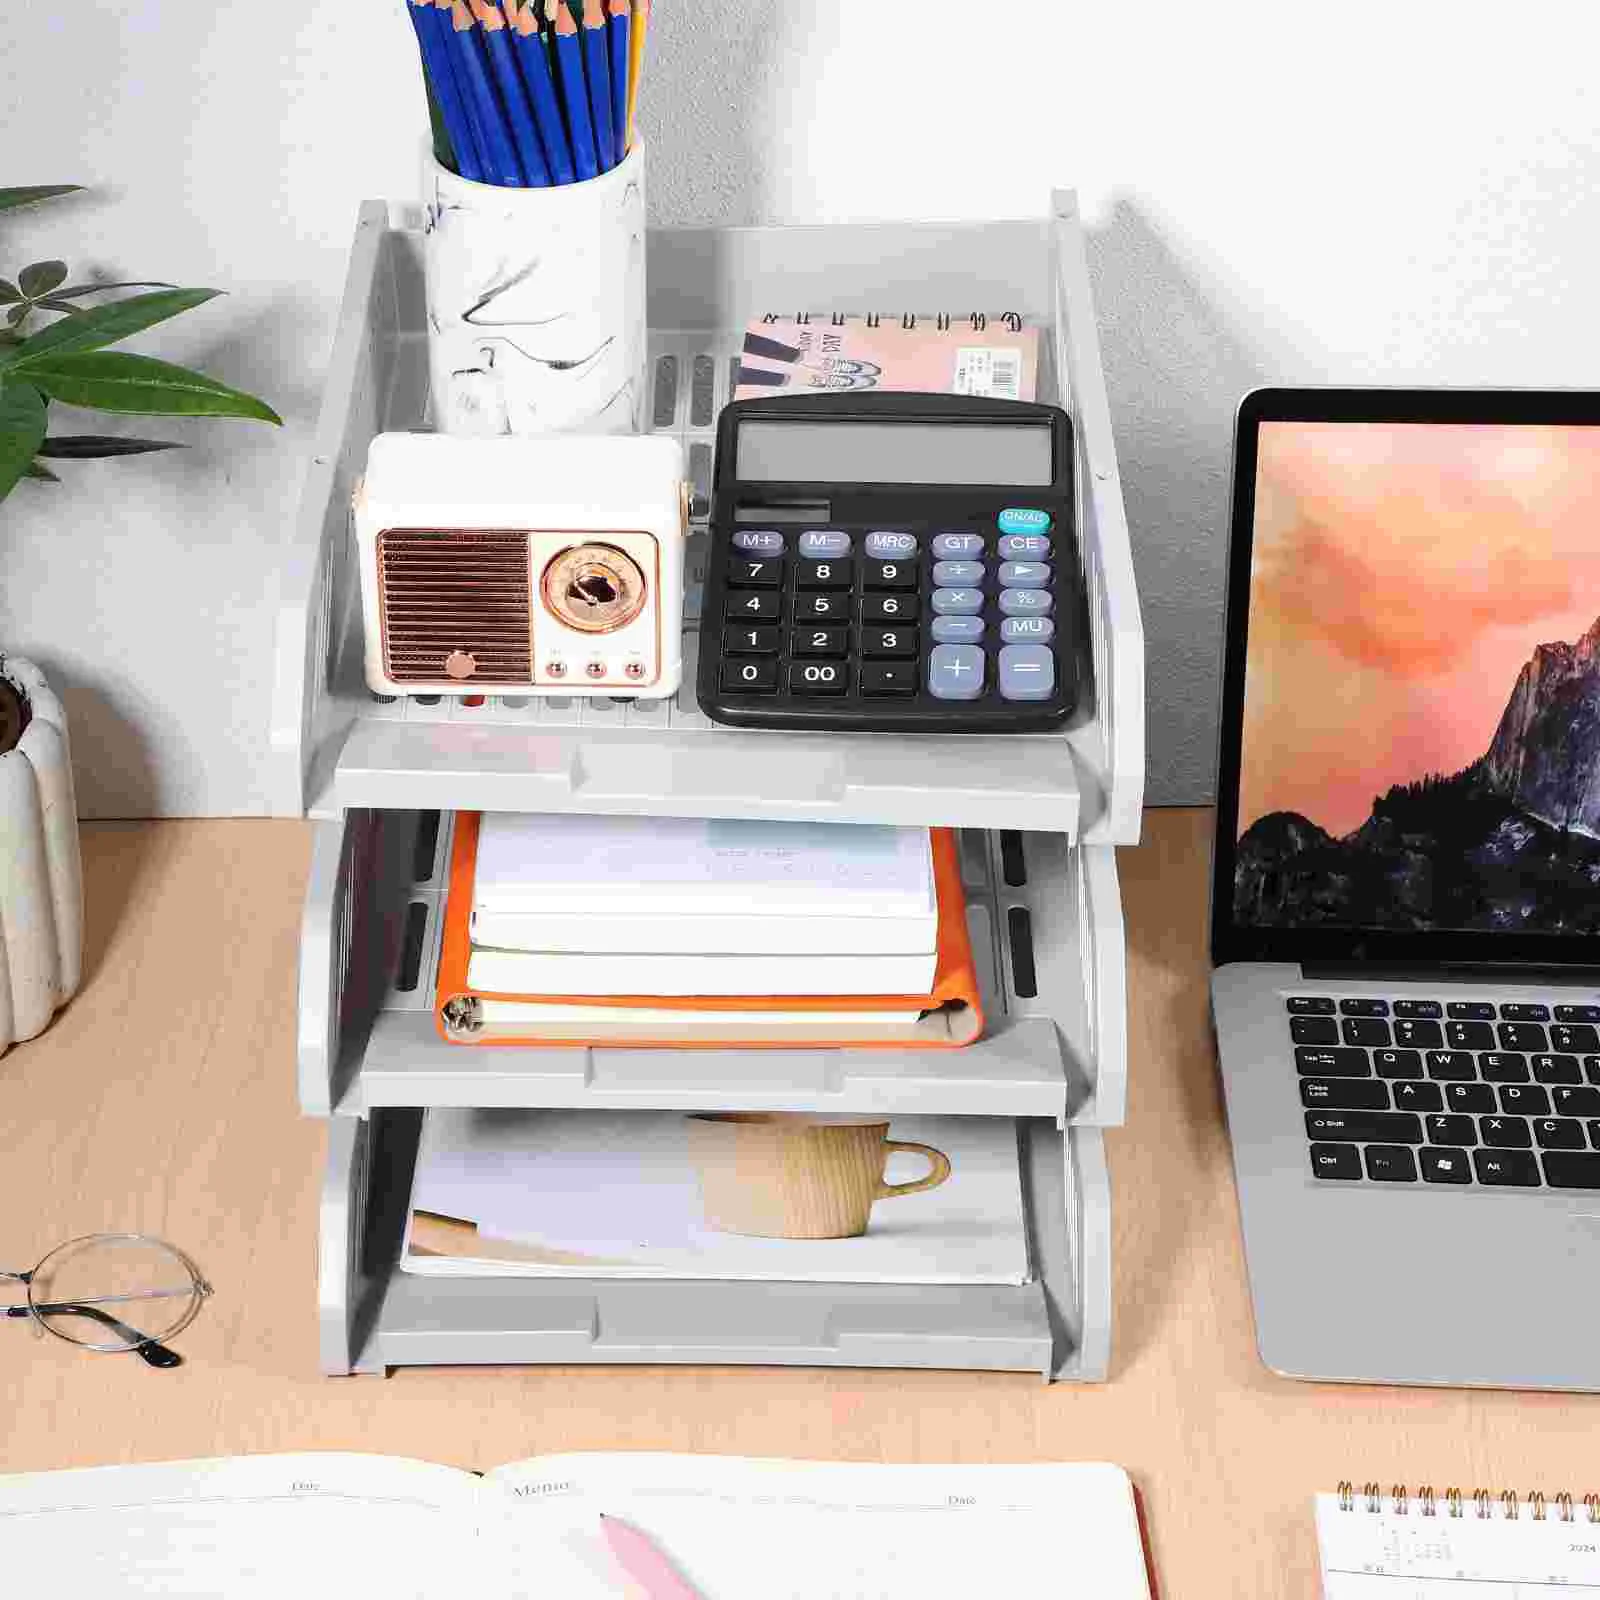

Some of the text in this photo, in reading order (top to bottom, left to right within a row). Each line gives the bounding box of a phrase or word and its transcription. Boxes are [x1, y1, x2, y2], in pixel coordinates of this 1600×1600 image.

[743, 534, 773, 546] M+
[873, 535, 912, 548] MRC
[944, 536, 970, 549] GT
[1010, 536, 1040, 549] CE
[750, 564, 763, 577] 7
[816, 565, 830, 579] 8
[882, 565, 897, 579] 9
[746, 598, 761, 611] 4
[815, 599, 829, 612] 5
[882, 599, 898, 613] 6
[1012, 620, 1043, 633] MU
[747, 632, 757, 645] 1
[812, 632, 828, 646] 2
[882, 634, 897, 647] 3
[742, 666, 757, 680] 0
[804, 666, 836, 681] 00
[1383, 1053, 1396, 1063] Q
[1436, 1054, 1451, 1064] W
[1488, 1056, 1501, 1066] E
[1541, 1058, 1553, 1068] R
[1402, 1085, 1415, 1095] A
[1455, 1087, 1467, 1096] S
[1508, 1088, 1521, 1098] D
[1562, 1090, 1572, 1099] F
[1435, 1117, 1448, 1128] Z
[1489, 1119, 1502, 1129] X
[1543, 1121, 1556, 1131] C
[1567, 1542, 1597, 1554] 2024
